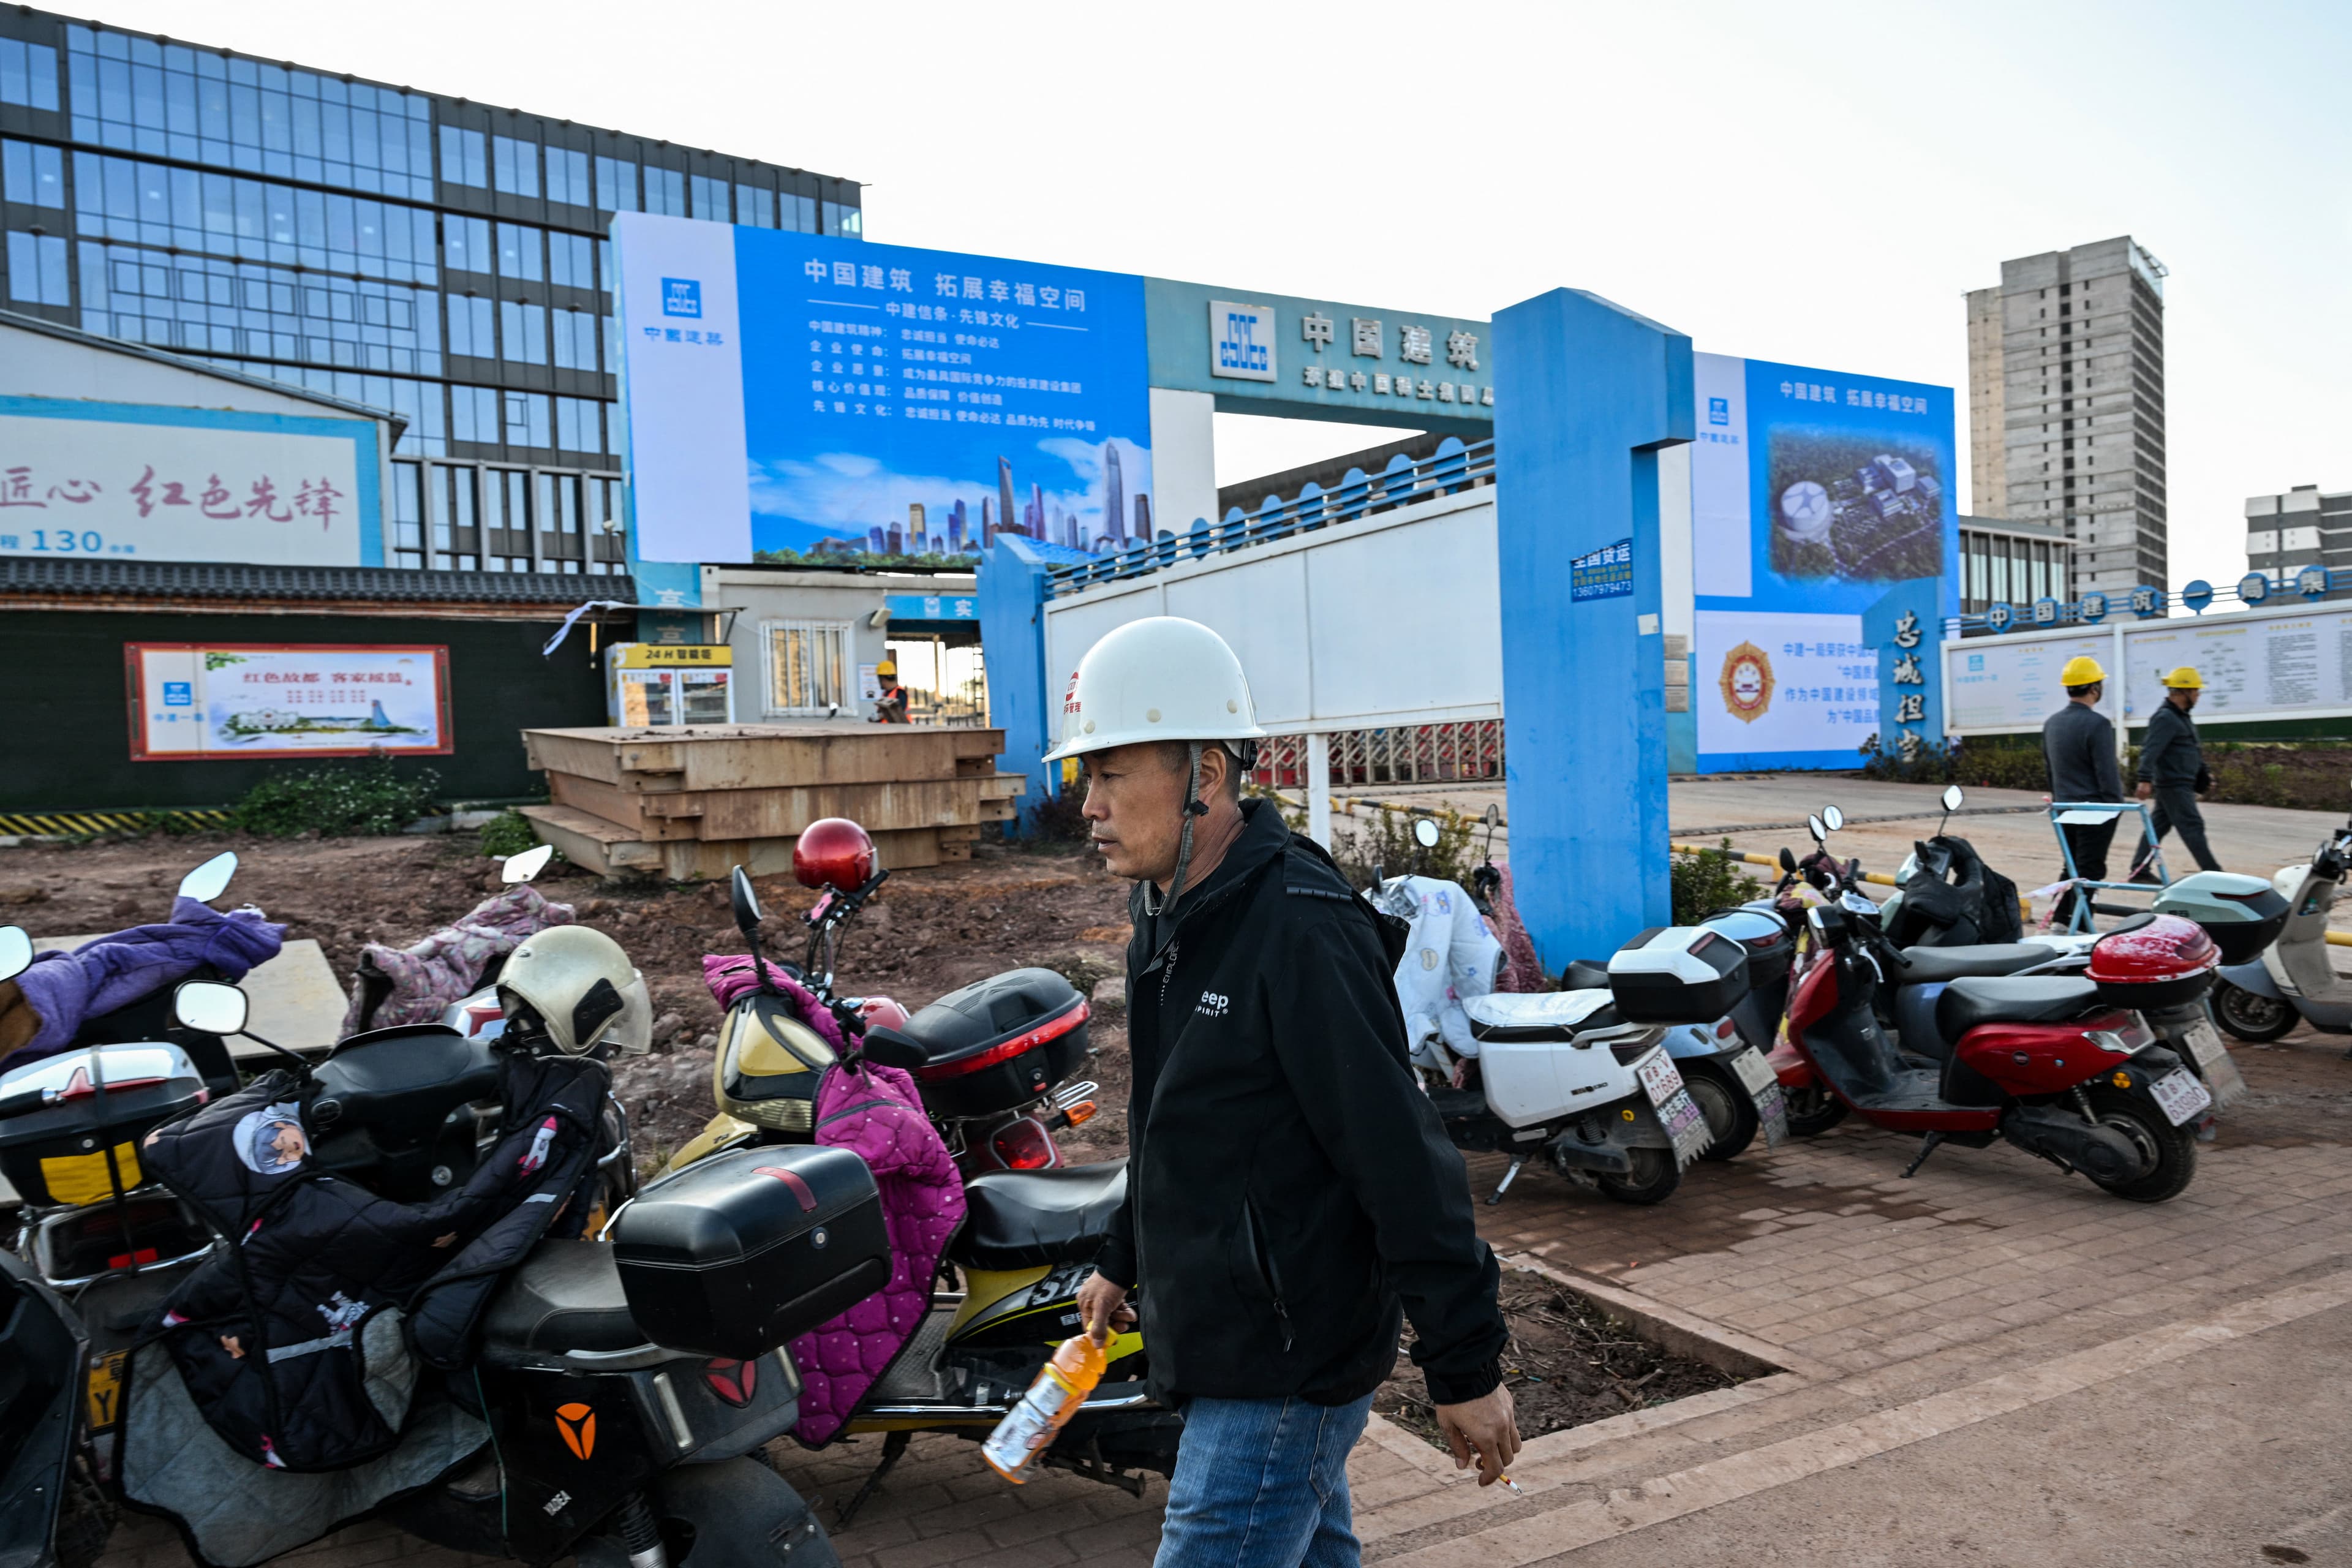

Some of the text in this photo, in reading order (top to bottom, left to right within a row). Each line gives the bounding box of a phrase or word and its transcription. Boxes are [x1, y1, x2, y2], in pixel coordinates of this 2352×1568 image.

[804, 258, 1086, 312] 中国建筑 拓展幸福空间
[1302, 311, 1480, 371] 中国建筑
[1780, 380, 1928, 415] 中国建筑 拓展幸福空间
[0, 464, 344, 532] 匠心 红色先锋
[31, 529, 102, 552] 130
[1650, 1070, 1680, 1102] 01689
